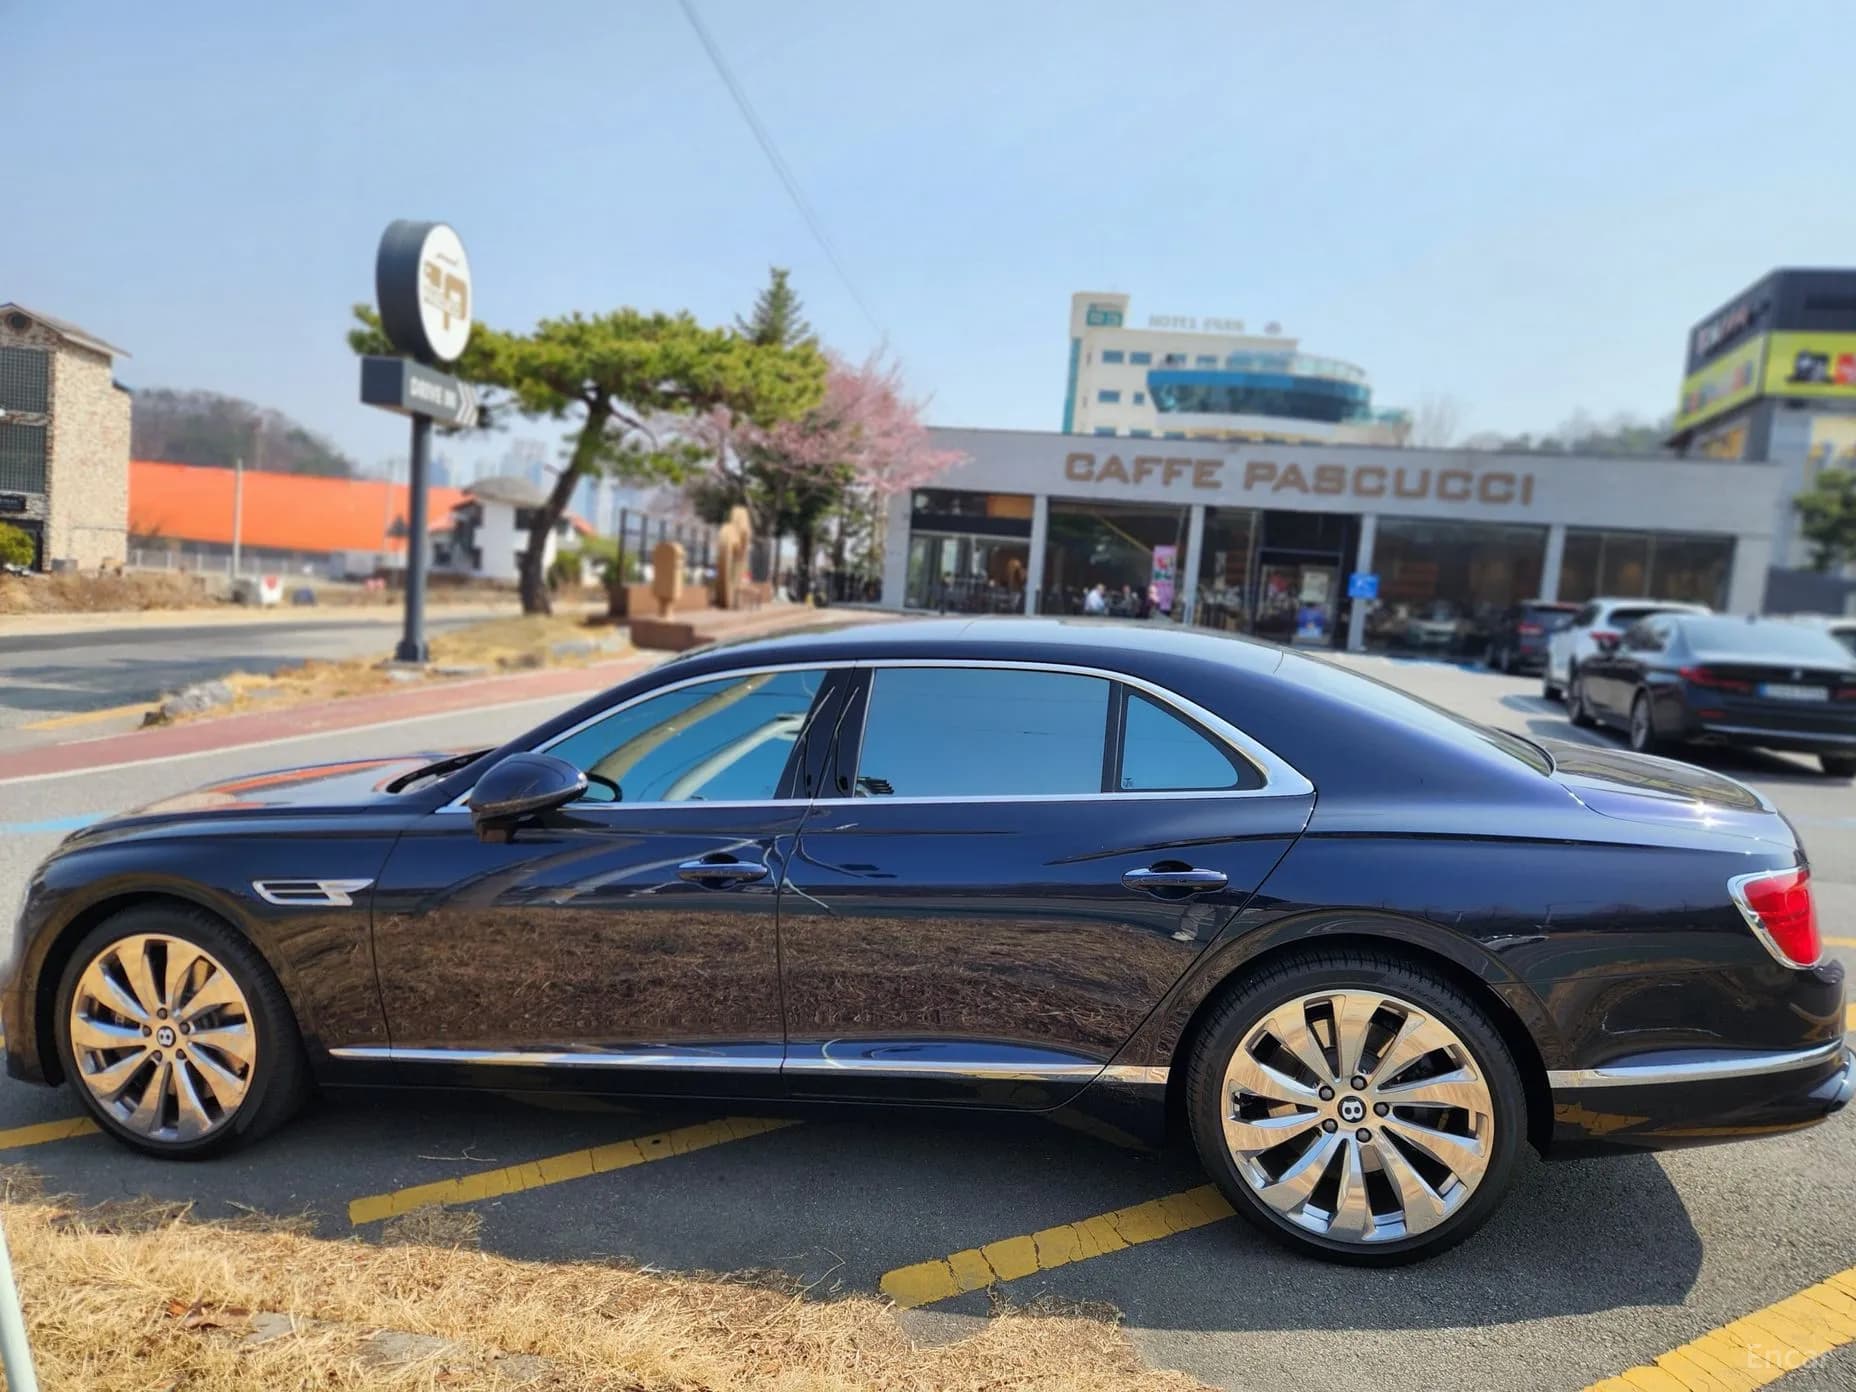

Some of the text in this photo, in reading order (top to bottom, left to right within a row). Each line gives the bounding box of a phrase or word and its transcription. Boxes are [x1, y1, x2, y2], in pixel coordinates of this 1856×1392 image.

[1065, 452, 1535, 507] CAFFE PASCUCCI
[1342, 1100, 1363, 1120] B
